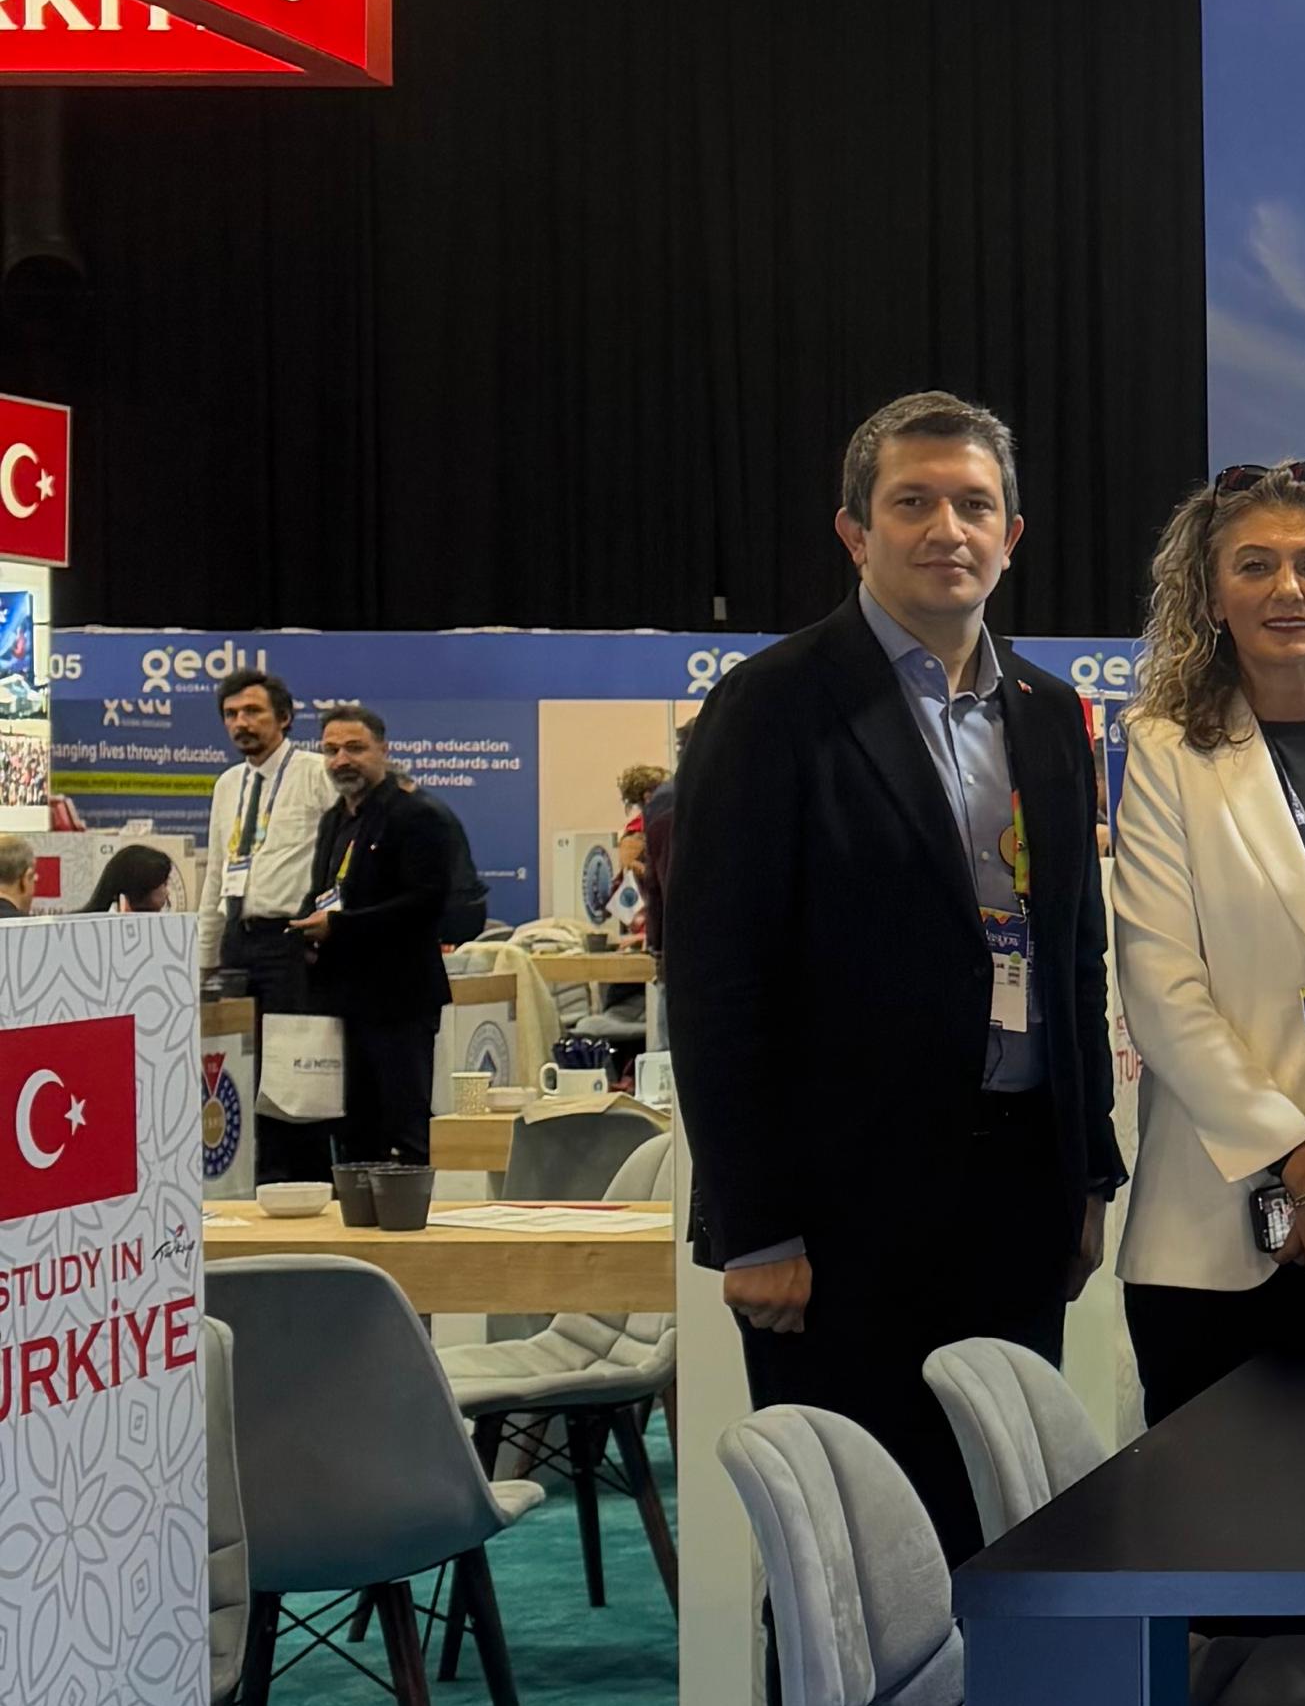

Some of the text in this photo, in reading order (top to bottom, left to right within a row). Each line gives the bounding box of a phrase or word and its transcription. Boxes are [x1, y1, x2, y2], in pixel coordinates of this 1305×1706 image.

[688, 648, 748, 694] ge
[51, 740, 97, 763] hanging
[99, 740, 125, 760] lives
[127, 742, 171, 765] through
[388, 739, 509, 754] rough education
[415, 756, 489, 770] standards
[491, 756, 520, 770] and
[412, 773, 476, 787] orldwide.
[112, 1238, 142, 1283] IN
[0, 1294, 196, 1423] RKİYE
